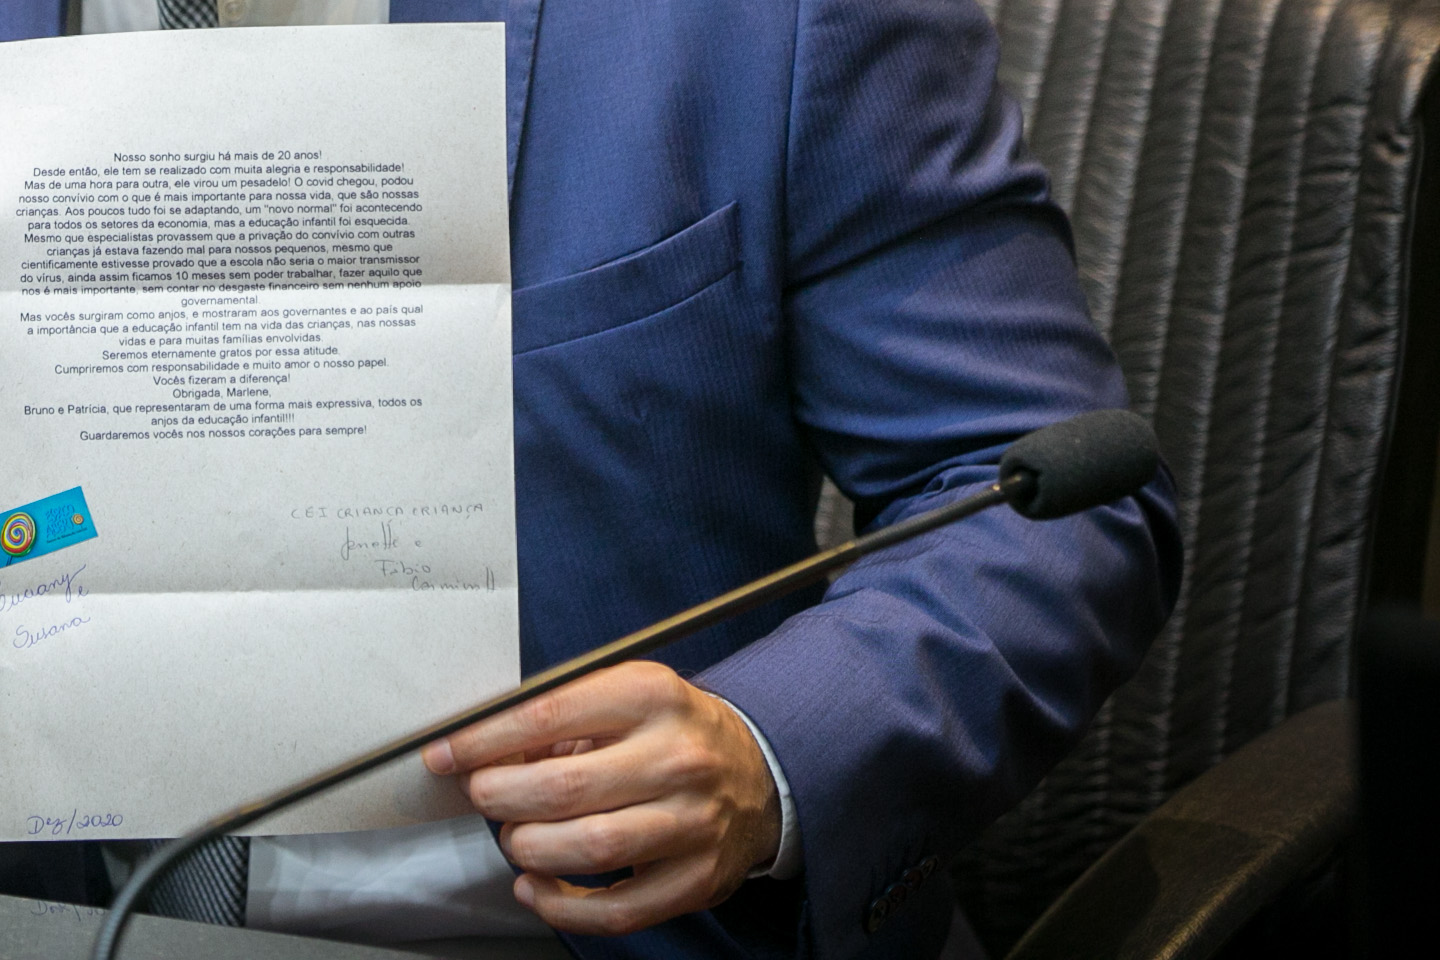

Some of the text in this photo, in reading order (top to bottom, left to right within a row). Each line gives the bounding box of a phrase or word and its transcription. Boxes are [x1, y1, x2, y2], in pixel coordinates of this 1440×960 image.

[113, 151, 322, 163] Nosso sonho surgiu há mais de 20 anos!
[32, 167, 66, 176] Desde
[68, 166, 100, 177] então,
[103, 166, 119, 175] ele
[121, 166, 141, 175] tem
[143, 167, 157, 175] se
[158, 165, 207, 175] realizado
[233, 164, 263, 174] muita
[265, 164, 301, 176] alegria
[312, 163, 405, 175] responsabilidade!
[18, 195, 50, 203] nosso
[51, 193, 95, 202] convívio
[97, 194, 119, 202] com
[130, 194, 151, 204] que
[163, 192, 188, 201] mais
[190, 191, 246, 203] importante
[248, 193, 273, 203] para
[274, 192, 307, 200] nossa
[308, 191, 334, 201] vida,
[336, 192, 357, 202] que
[359, 190, 379, 200] são
[381, 191, 420, 199] nossas
[64, 206, 85, 215] Aos
[87, 207, 125, 217] poucos
[127, 205, 151, 215] tudo
[152, 205, 166, 215] foi
[183, 204, 242, 216] adaptando,
[244, 206, 261, 214] um
[263, 204, 294, 214] "novo
[296, 204, 337, 213] normal"
[339, 203, 353, 213] foi
[354, 203, 423, 213] acontecendo
[27, 222, 51, 231] para
[53, 220, 82, 229] todos
[84, 221, 98, 229] os
[100, 219, 139, 229] setores
[140, 219, 155, 228] da
[157, 218, 210, 229] economia,
[248, 217, 300, 229] educação
[301, 217, 336, 227] infantil
[338, 217, 351, 226] foi
[23, 233, 62, 243] Mesmo
[64, 235, 85, 244] que
[86, 232, 154, 244] especialistas
[156, 233, 213, 243] provassem
[215, 233, 236, 243] que
[247, 230, 293, 242] privação
[294, 230, 309, 240] do
[311, 230, 355, 239] convívio
[356, 231, 380, 239] com
[381, 229, 416, 239] outras
[46, 244, 393, 258] crianças já estava fazendo mal para nossos pequenos, mesmo que
[20, 259, 99, 269] cientificamente
[100, 258, 150, 268] estivesse
[151, 258, 195, 269] provado
[197, 259, 218, 269] que
[229, 257, 264, 266] escola
[265, 256, 287, 266] não
[288, 256, 315, 266] seria
[326, 255, 357, 265] maior
[358, 254, 420, 265] transmissor
[118, 336, 146, 346] vidas
[158, 337, 182, 347] para
[185, 335, 219, 345] muitas
[222, 334, 263, 344] famílias
[101, 349, 148, 359] Seremos
[150, 348, 216, 359] eternamente
[218, 348, 252, 360] gratos
[254, 349, 272, 359] por
[274, 349, 300, 357] essa
[54, 363, 124, 376] Cumpriremos
[126, 364, 149, 372] com
[151, 361, 240, 374] responsabilidade
[252, 360, 282, 370] muito
[283, 361, 311, 369] amor
[322, 360, 355, 368] nosso
[357, 358, 389, 370] papel.
[172, 387, 271, 400] Obrigada, Marlene,
[23, 405, 55, 415] Bruno
[66, 404, 109, 415] Patrícia,
[112, 405, 132, 415] que
[134, 402, 210, 414] representaram
[212, 401, 227, 411] de
[228, 402, 252, 410] uma
[254, 400, 285, 410] forma
[287, 399, 313, 409] mais
[315, 398, 375, 411] expressiva,
[377, 397, 407, 407] todos
[150, 414, 295, 428] anjos da educação infantil!!!
[79, 426, 367, 440] Guardaremos vocês nos nossos corações para sempre!
[290, 506, 328, 519] CEI
[411, 503, 484, 520] CRIANÇA
[12, 615, 92, 650] Susana
